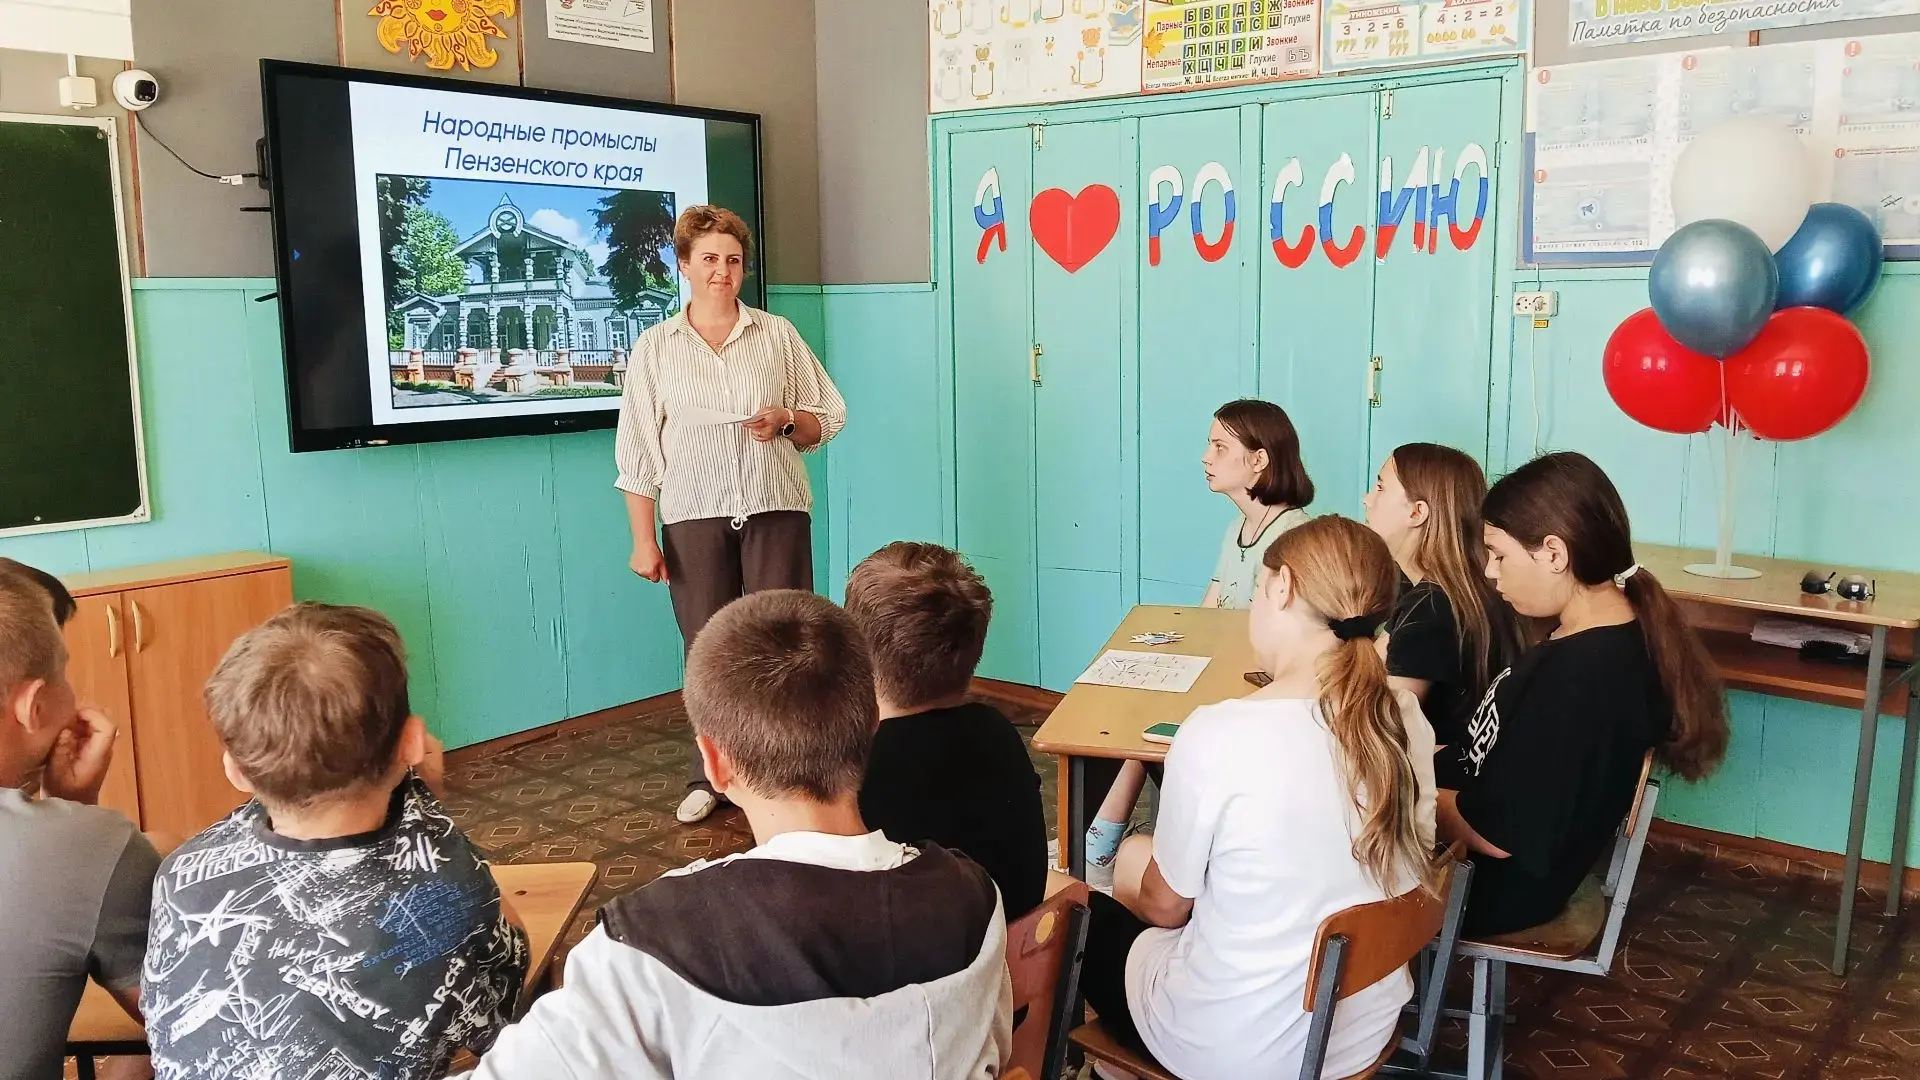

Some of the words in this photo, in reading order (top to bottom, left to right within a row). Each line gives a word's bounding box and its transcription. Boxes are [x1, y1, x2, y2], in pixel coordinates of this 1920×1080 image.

[1187, 10, 1195, 22] Б
[1203, 8, 1211, 20] В
[1220, 6, 1227, 18] Г
[1236, 4, 1245, 17] Д
[1254, 2, 1261, 13] З
[1269, 0, 1280, 11] Ж
[1350, 7, 1398, 19] УМНОЖЕНИЕ
[1437, 13, 1445, 24] 4
[1464, 10, 1473, 22] 2
[1494, 5, 1503, 17] 2
[1156, 20, 1183, 32] Парные
[1186, 26, 1195, 38] П
[1201, 24, 1211, 36] Ф
[1218, 22, 1226, 34] К
[1236, 20, 1244, 31] Т
[1253, 18, 1260, 30] С
[1269, 16, 1280, 28] Ш
[1283, 14, 1311, 27] Глухие
[1343, 24, 1351, 36] 3
[1367, 22, 1376, 33] 2
[1396, 18, 1404, 29] 6
[1572, 19, 1662, 42] Памятка
[1669, 15, 1692, 29] по
[1185, 46, 1194, 57] Л
[1201, 44, 1211, 55] М
[1217, 42, 1226, 54] Н
[1236, 40, 1243, 52] Р
[1266, 35, 1298, 47] Звонкие
[1146, 58, 1182, 69] Непарные
[1185, 62, 1194, 73] Х
[1200, 60, 1210, 73] Ц
[1217, 58, 1225, 69] Ч
[1249, 54, 1277, 66] Глухие
[422, 110, 546, 142] Народные
[551, 127, 658, 153] промыслы
[444, 147, 588, 179] Пензенского
[593, 163, 644, 185] края
[973, 165, 1008, 265] Я
[1148, 142, 1489, 269] РОССИЮ
